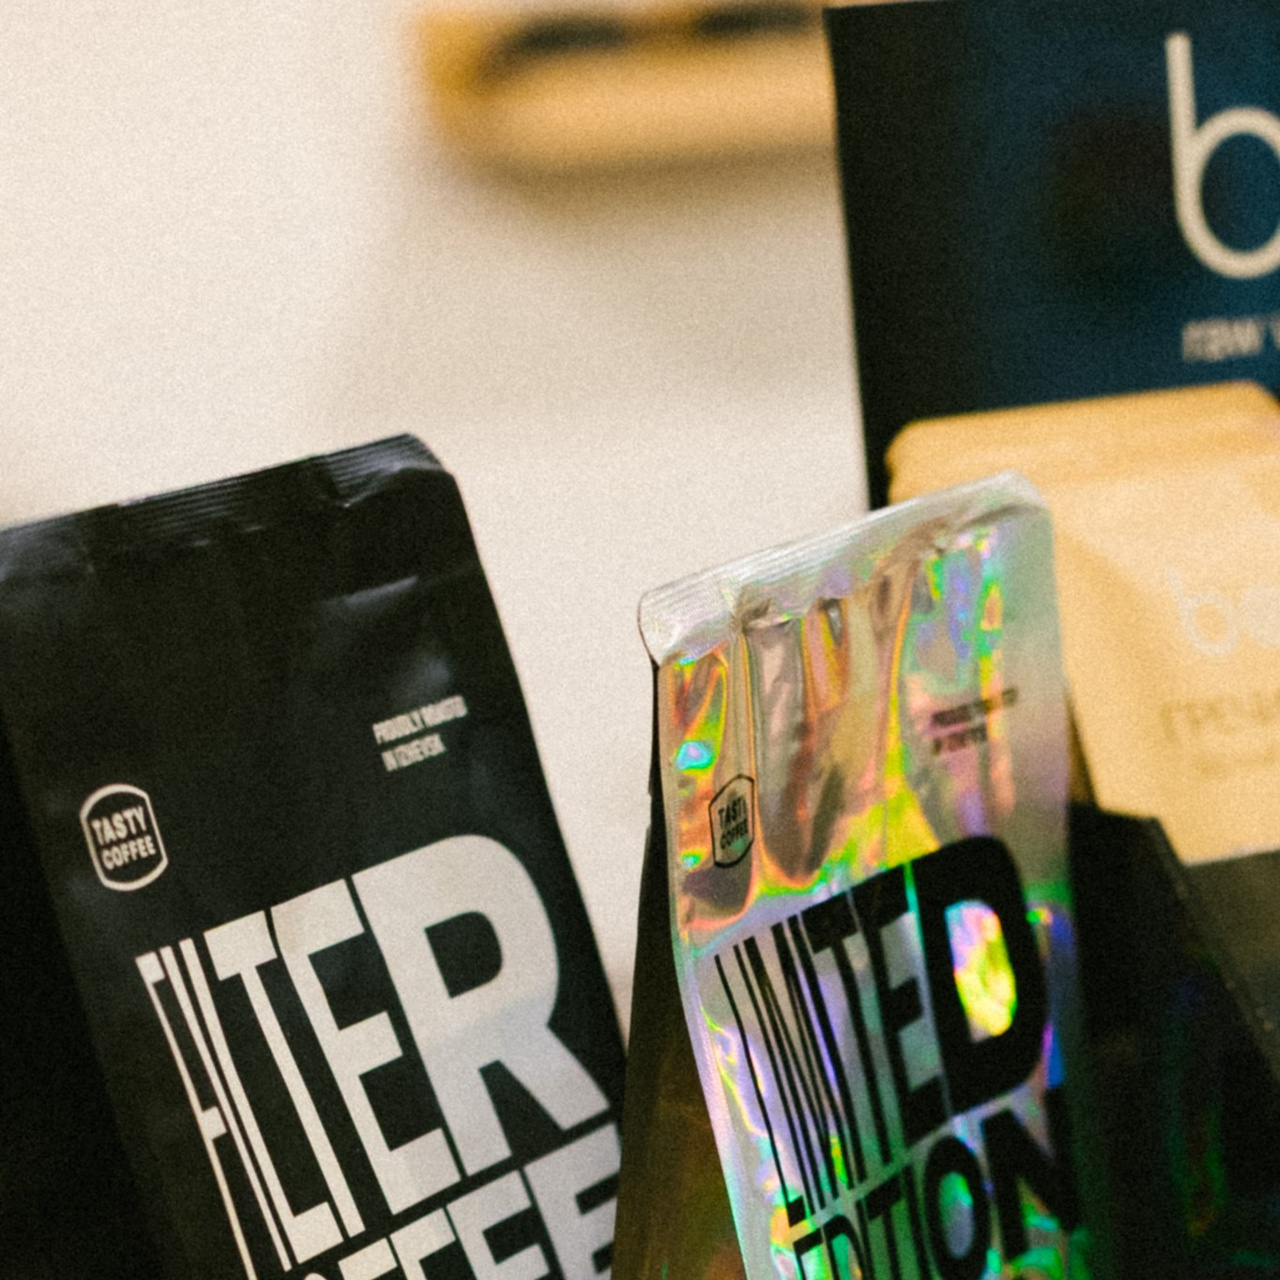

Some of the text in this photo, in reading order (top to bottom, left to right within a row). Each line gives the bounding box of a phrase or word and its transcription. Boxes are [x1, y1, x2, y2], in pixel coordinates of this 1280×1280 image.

[91, 805, 147, 846] TASTY
[101, 835, 157, 871] COFFEE
[713, 835, 1049, 1228] LIMITED
